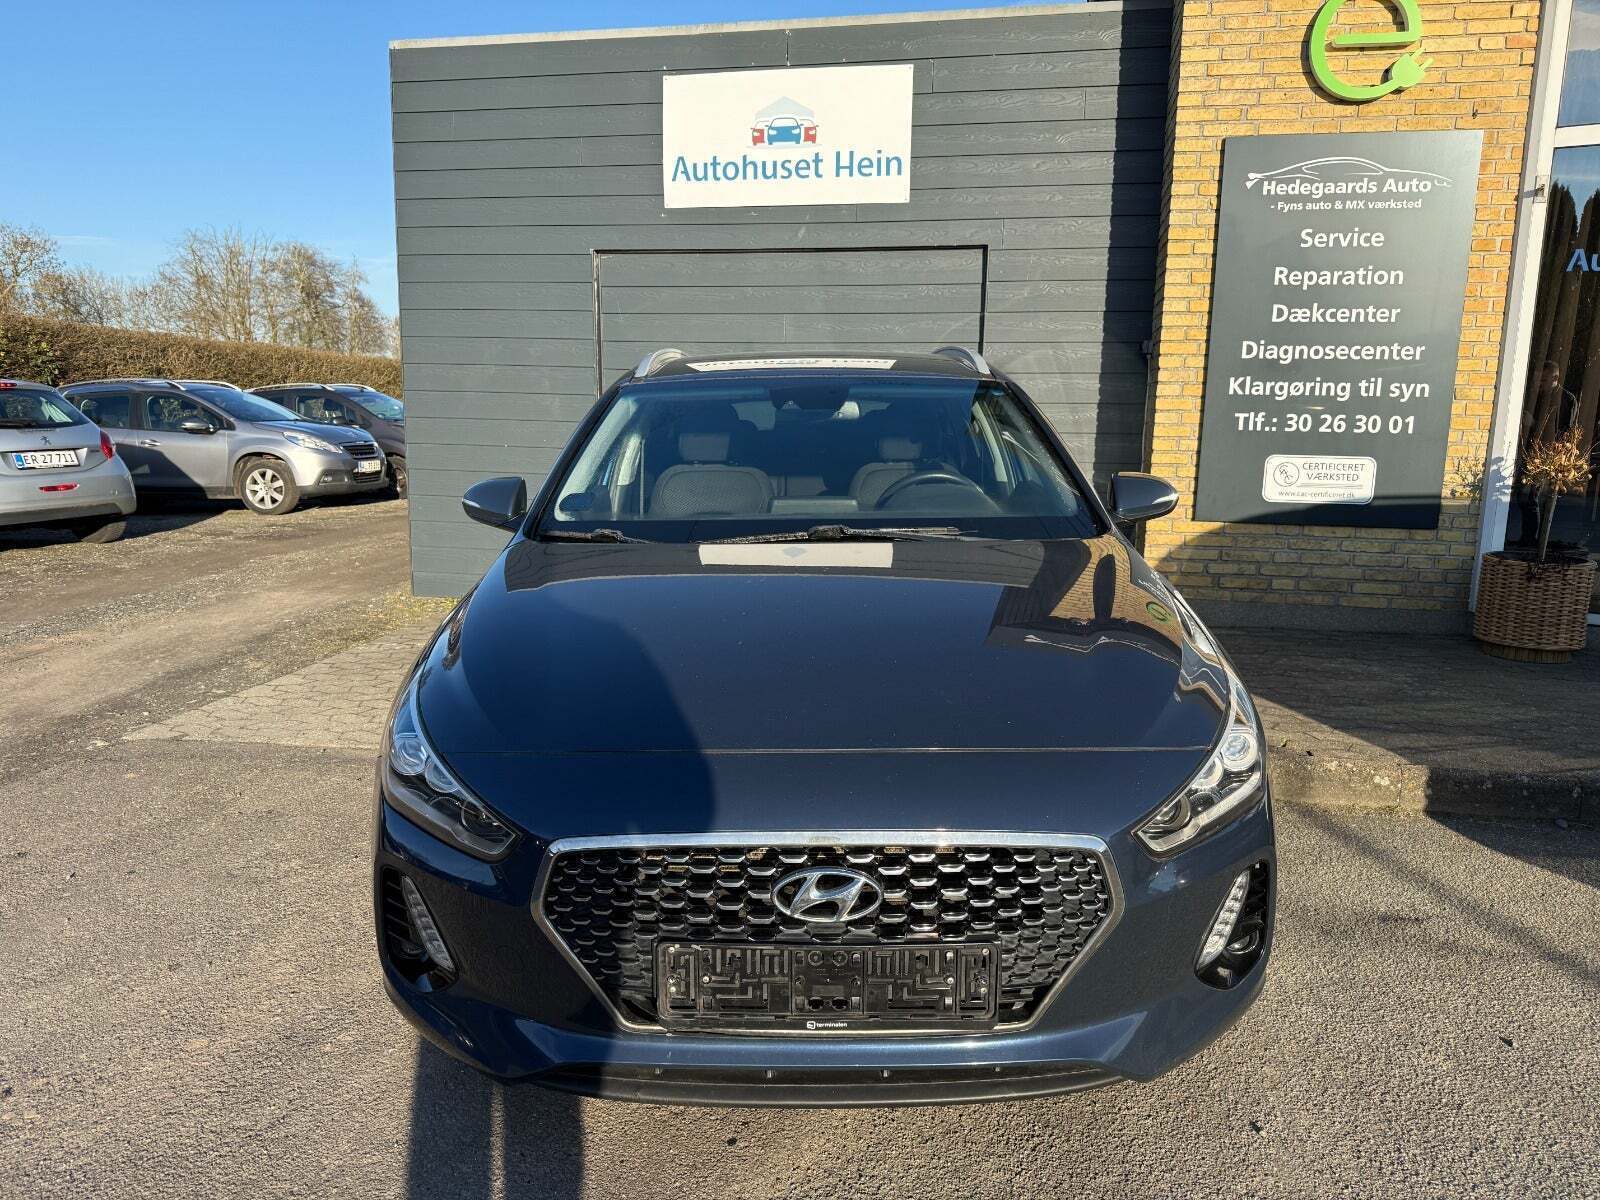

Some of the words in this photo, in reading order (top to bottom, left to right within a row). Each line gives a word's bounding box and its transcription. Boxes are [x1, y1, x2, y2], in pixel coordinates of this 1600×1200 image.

[671, 151, 824, 182] Autohuset
[834, 149, 903, 178] Hein
[1262, 178, 1378, 199] Hedegaards
[1382, 177, 1432, 194] Auto
[1277, 201, 1303, 213] Fyns
[1305, 200, 1332, 211] auto
[1334, 200, 1344, 210] &
[1345, 200, 1365, 210] MX
[1367, 198, 1422, 209] værksted
[1300, 227, 1385, 248] Service
[1273, 265, 1404, 290] Reparation
[1271, 302, 1401, 323] Dækcenter
[1241, 339, 1426, 365] Diagnosecenter
[1228, 376, 1351, 401] Klargøring
[1358, 377, 1382, 398] til
[1388, 382, 1430, 402] syn
[1234, 411, 1277, 432] Tlf.:
[1284, 413, 1313, 433] 30
[1318, 414, 1347, 434] 26
[1352, 414, 1382, 434] 30
[1388, 415, 1415, 435] 01
[1302, 462, 1366, 472] CERTIFICERET
[1306, 472, 1359, 482] VÆRKSTED
